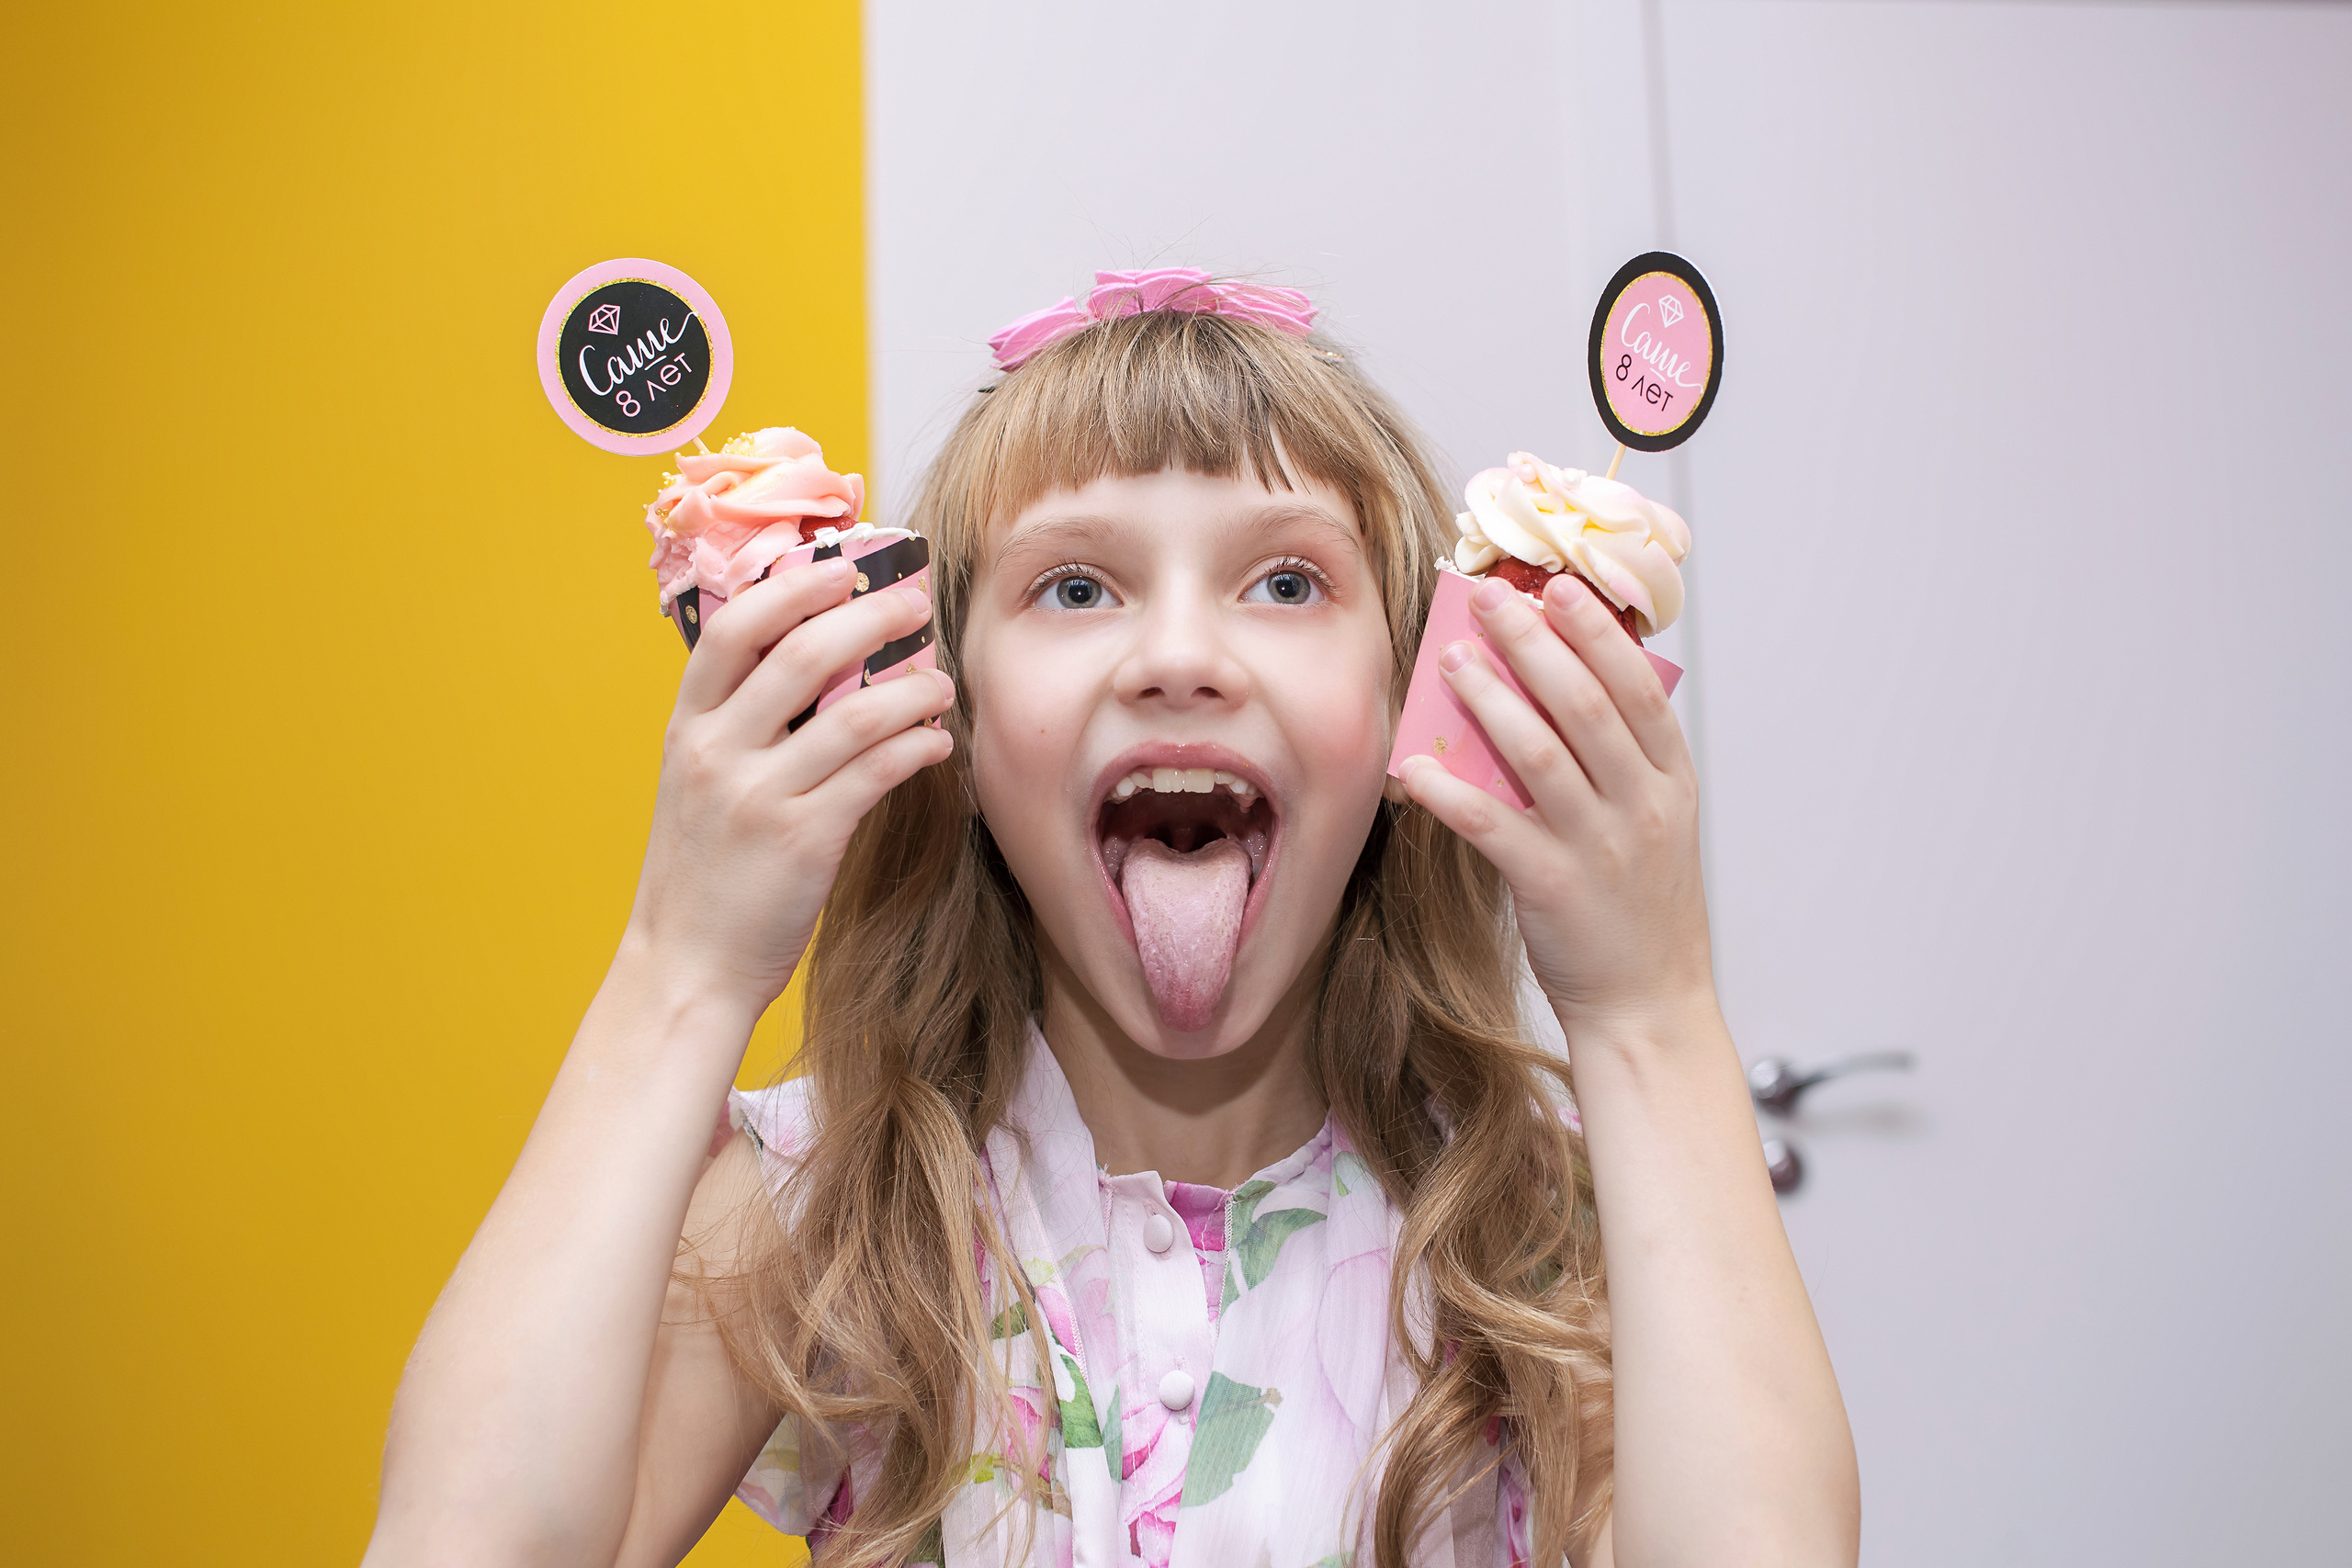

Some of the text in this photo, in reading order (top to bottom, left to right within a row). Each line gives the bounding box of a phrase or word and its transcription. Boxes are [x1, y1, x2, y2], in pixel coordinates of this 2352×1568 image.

[579, 311, 698, 396] Саше
[616, 353, 692, 417] 8 лет
[1616, 354, 1673, 412] 8 лет
[1621, 303, 1704, 394] Саше
